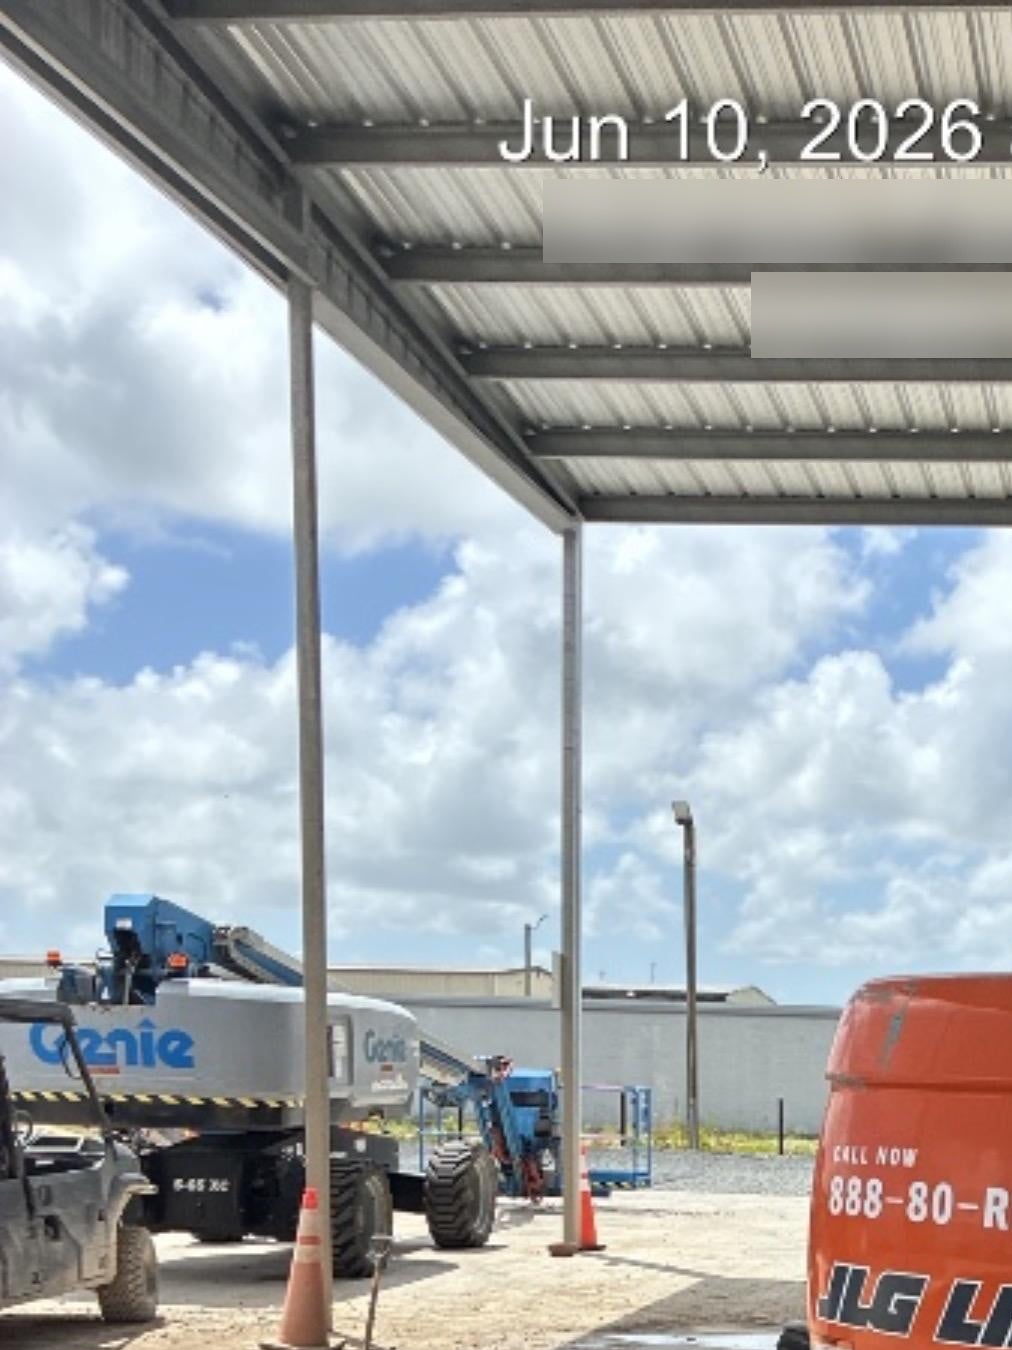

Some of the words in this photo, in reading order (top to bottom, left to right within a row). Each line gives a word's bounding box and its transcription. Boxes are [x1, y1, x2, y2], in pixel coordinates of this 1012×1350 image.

[29, 1017, 195, 1069] Genie
[832, 1144, 868, 1166] CALL
[875, 1145, 919, 1168] NOW
[816, 1260, 931, 1339] JLG
